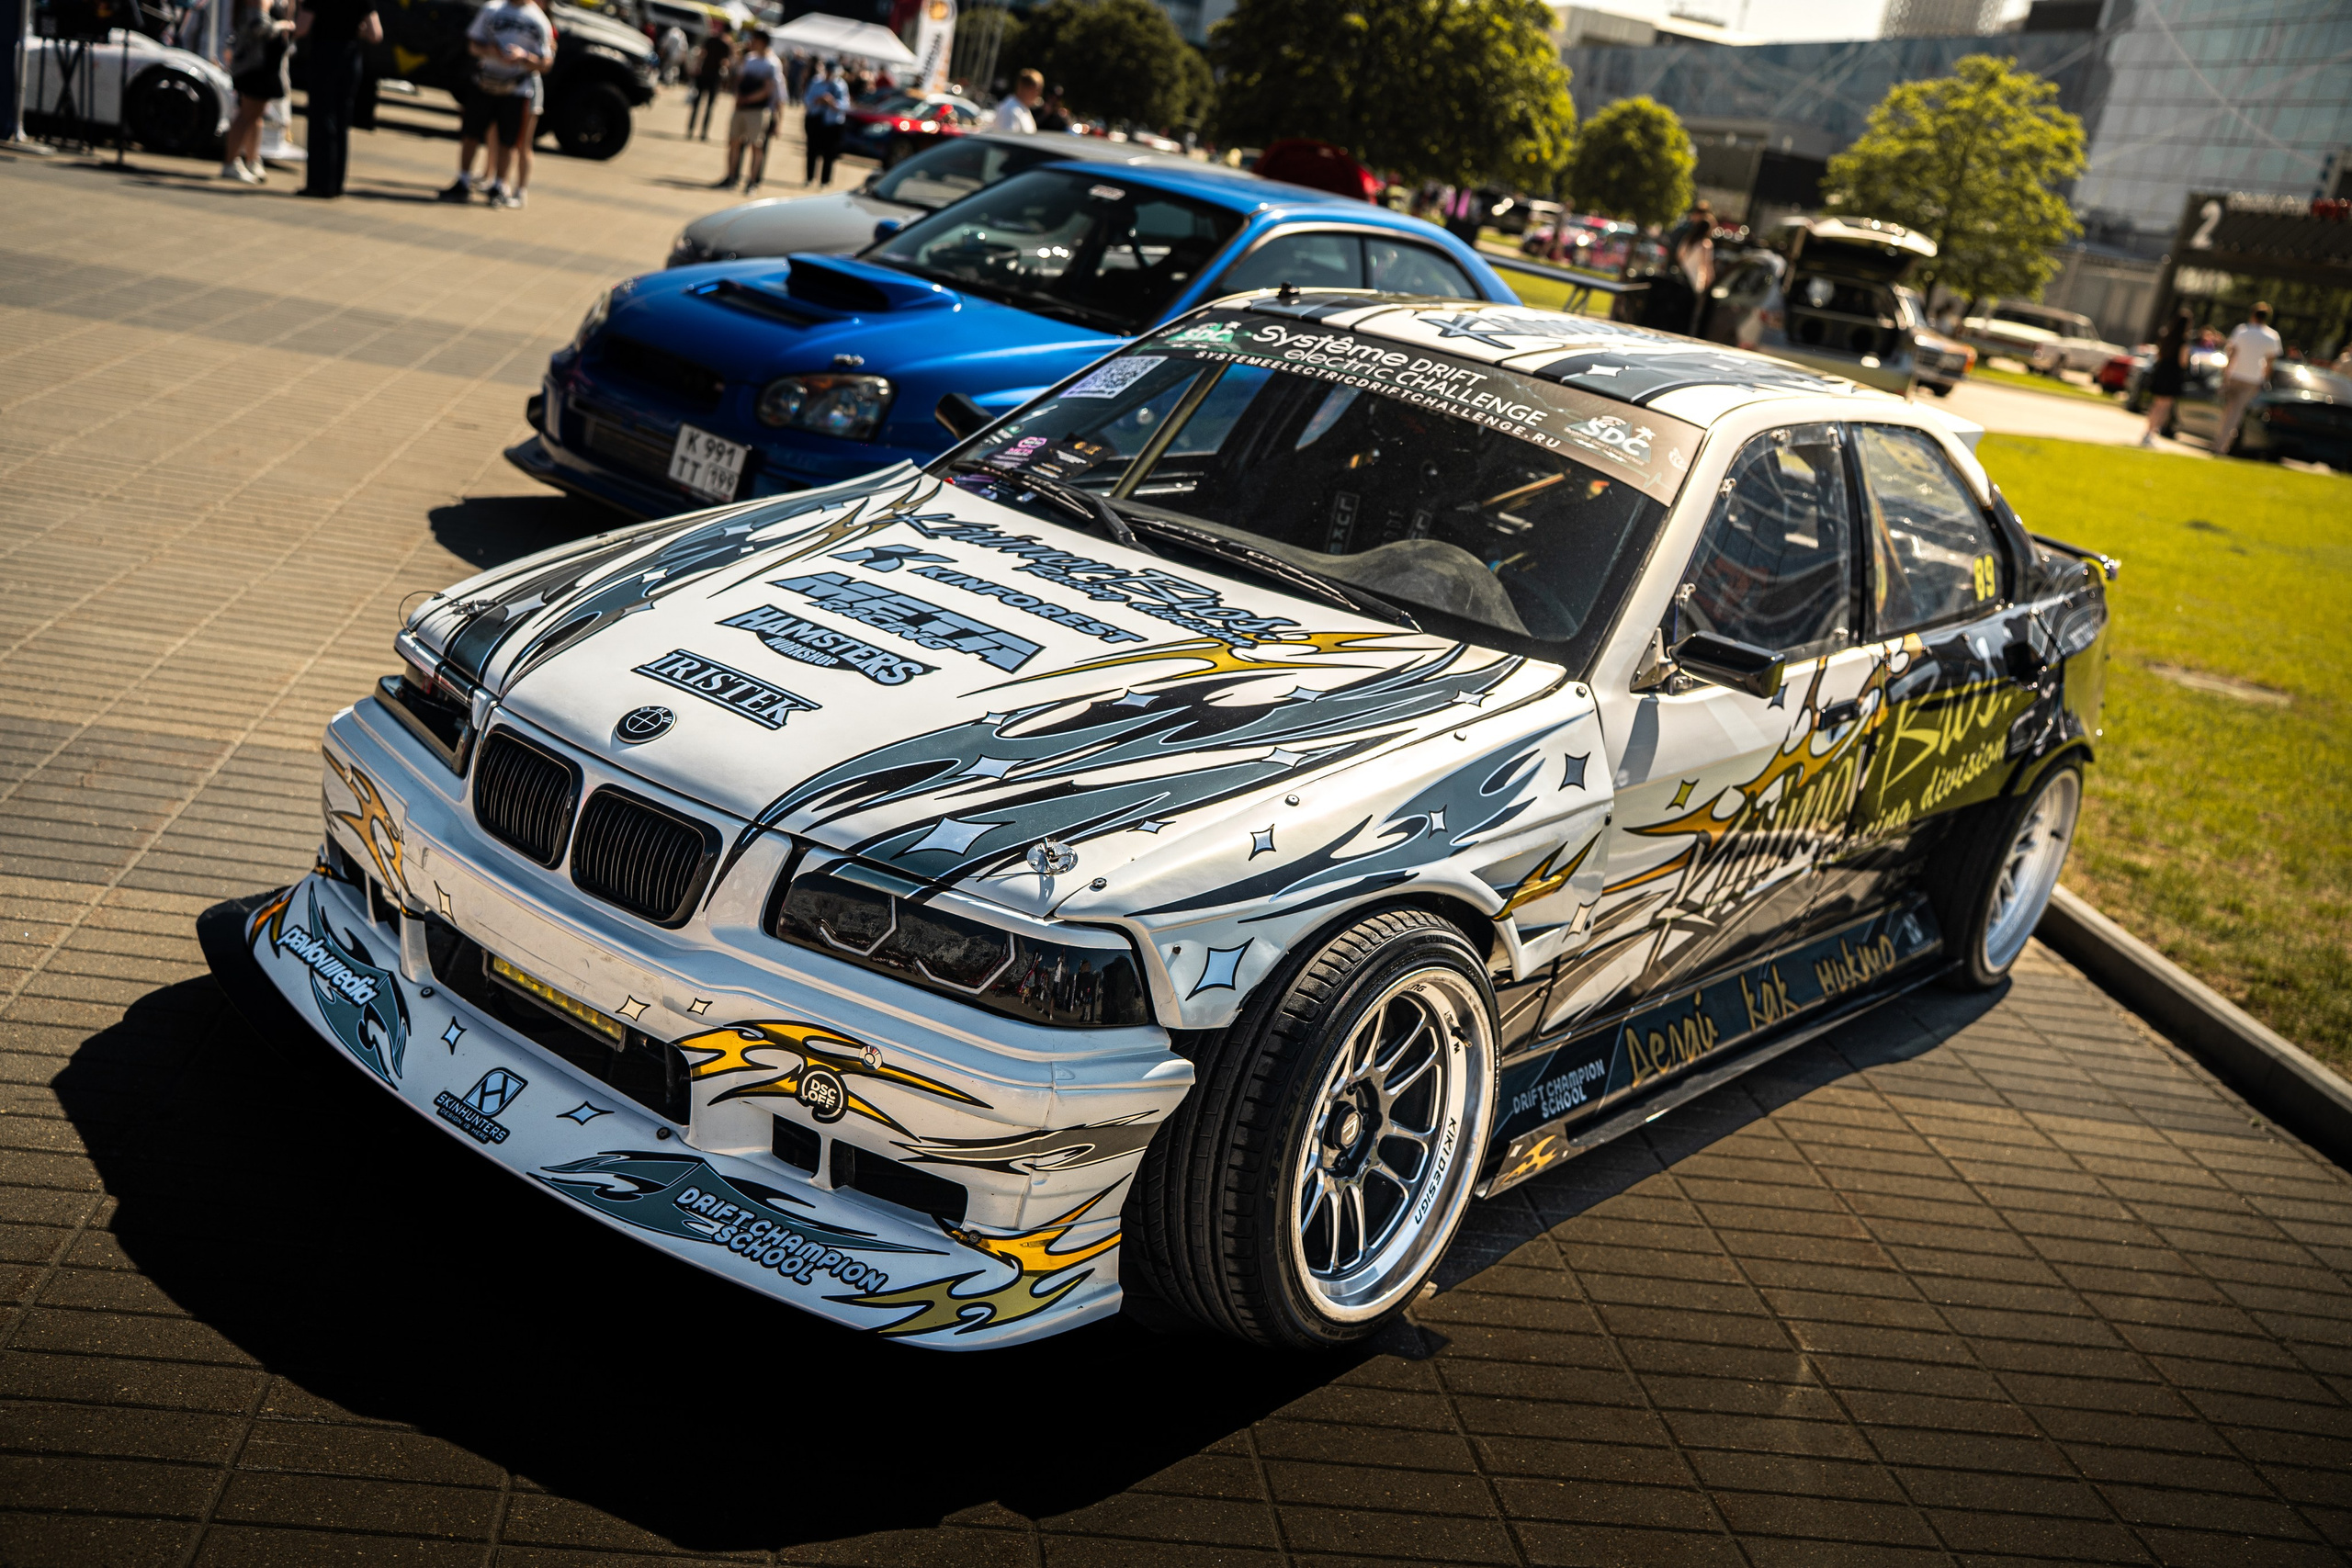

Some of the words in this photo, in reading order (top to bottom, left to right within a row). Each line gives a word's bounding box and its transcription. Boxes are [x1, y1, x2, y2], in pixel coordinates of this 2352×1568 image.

[2190, 199, 2222, 249] 2
[1252, 325, 1408, 367] Systême
[1408, 358, 1487, 386] DRIFT
[1195, 350, 1561, 448] SYSTEMEELECTRICDRIFTCHALLENGE.RU
[1284, 348, 1394, 379] electric
[1396, 371, 1548, 426] CHALLENGE
[705, 438, 737, 467] 991
[1579, 416, 1650, 457] SDC
[709, 469, 735, 492] 199
[907, 565, 1148, 643] KINFOREST
[1012, 562, 1131, 603] Racing
[718, 605, 925, 685] HAMSTERS
[765, 571, 1046, 674] META
[805, 597, 959, 650] RACING
[764, 637, 840, 667] WORKSHOP
[644, 652, 811, 726] IRISTEK
[1919, 734, 2008, 811] division
[1740, 964, 1801, 1032] как
[808, 1089, 836, 1109] OFF
[810, 1078, 837, 1100] DSC
[1512, 1085, 1544, 1114] DRIFT
[1546, 1058, 1605, 1098] CHAMPION
[1541, 1085, 1588, 1119] SCHOOL
[436, 1093, 507, 1141] SKINHUNTERS
[440, 1107, 463, 1124] DESIGN
[470, 1127, 490, 1141] HERE
[1443, 1117, 1457, 1156] KIKI
[1415, 1156, 1446, 1224] DESIGN
[676, 1187, 755, 1227] DRIFT
[749, 1219, 886, 1292] CHAMPION
[714, 1224, 813, 1283] SCHOOL
